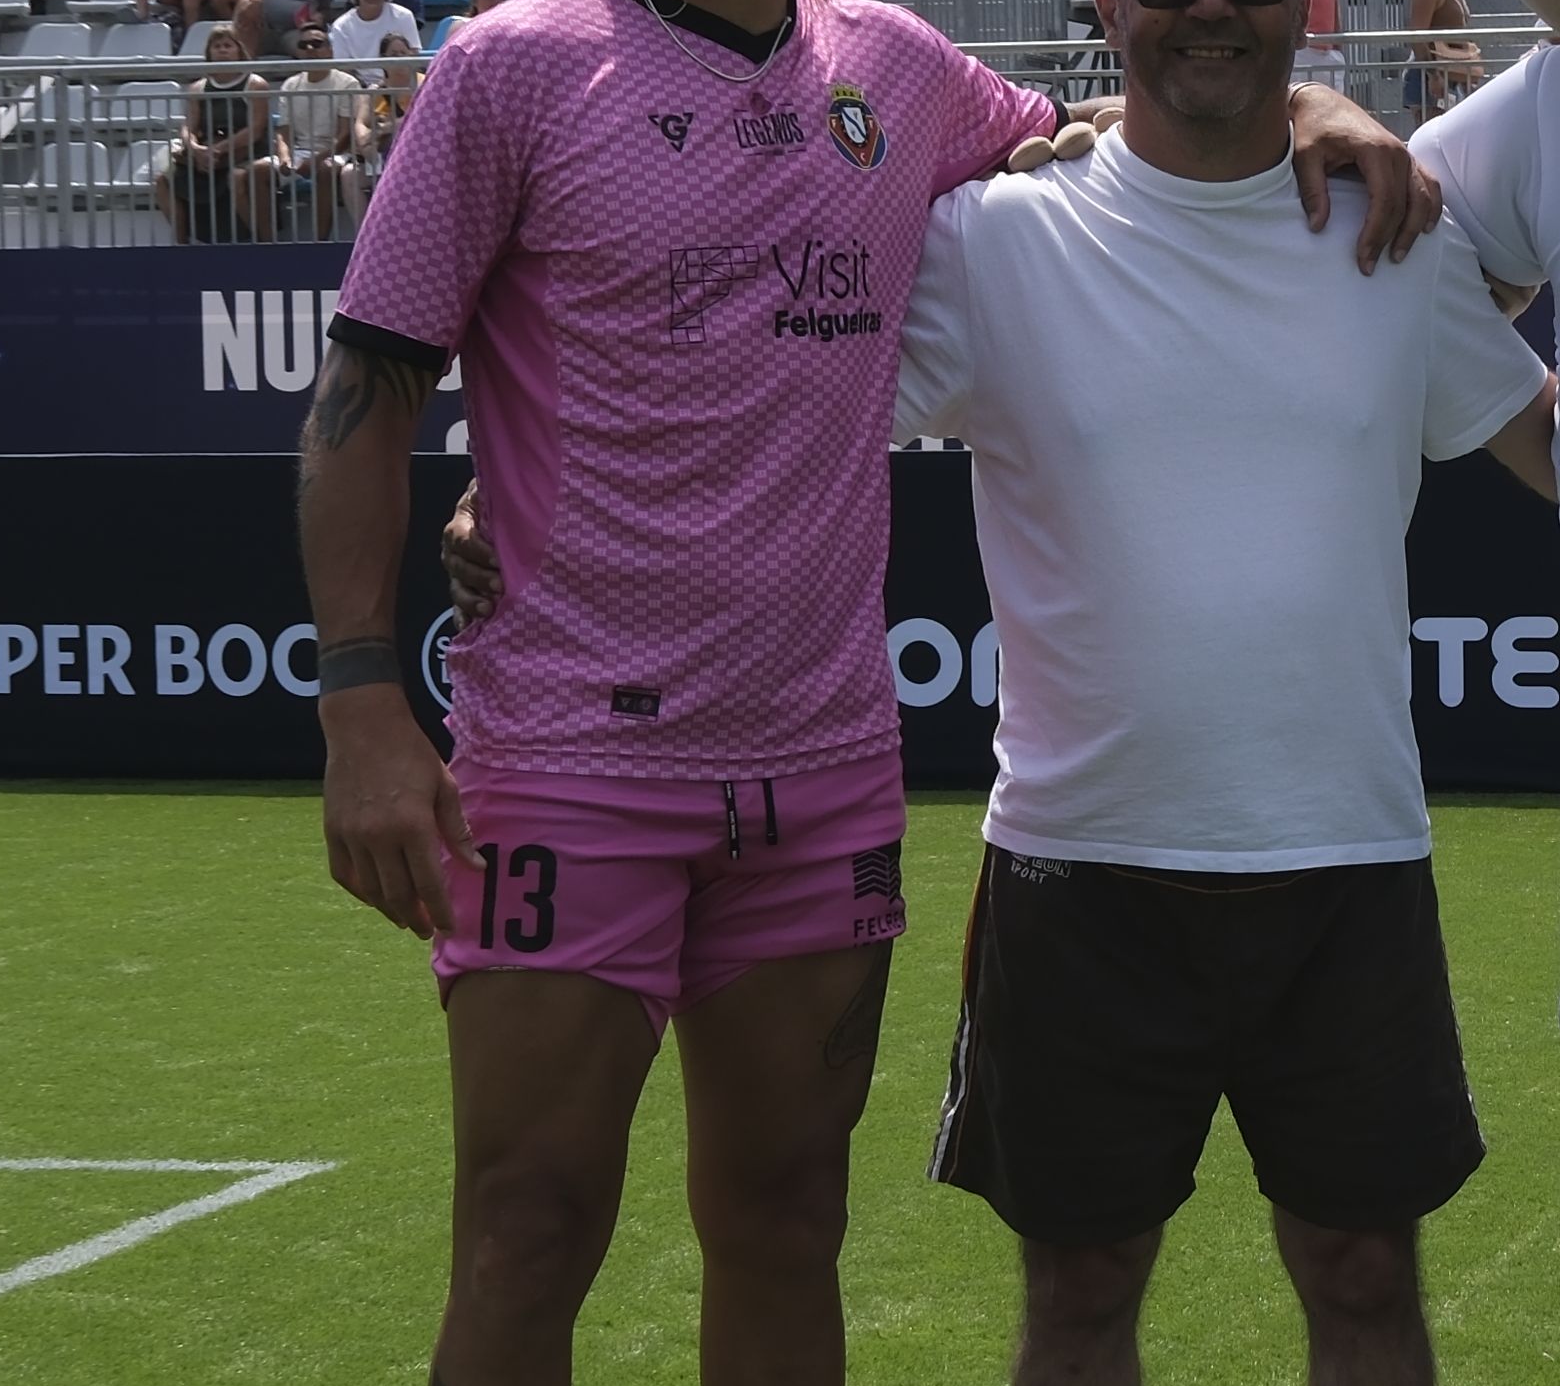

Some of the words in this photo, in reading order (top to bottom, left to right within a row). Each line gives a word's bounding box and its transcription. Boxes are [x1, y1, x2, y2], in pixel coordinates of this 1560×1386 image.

[733, 111, 805, 149] LEGENDS
[771, 239, 871, 300] Visit
[774, 307, 881, 342] Felgueiras
[154, 623, 320, 697] BOC
[476, 842, 558, 954] 13
